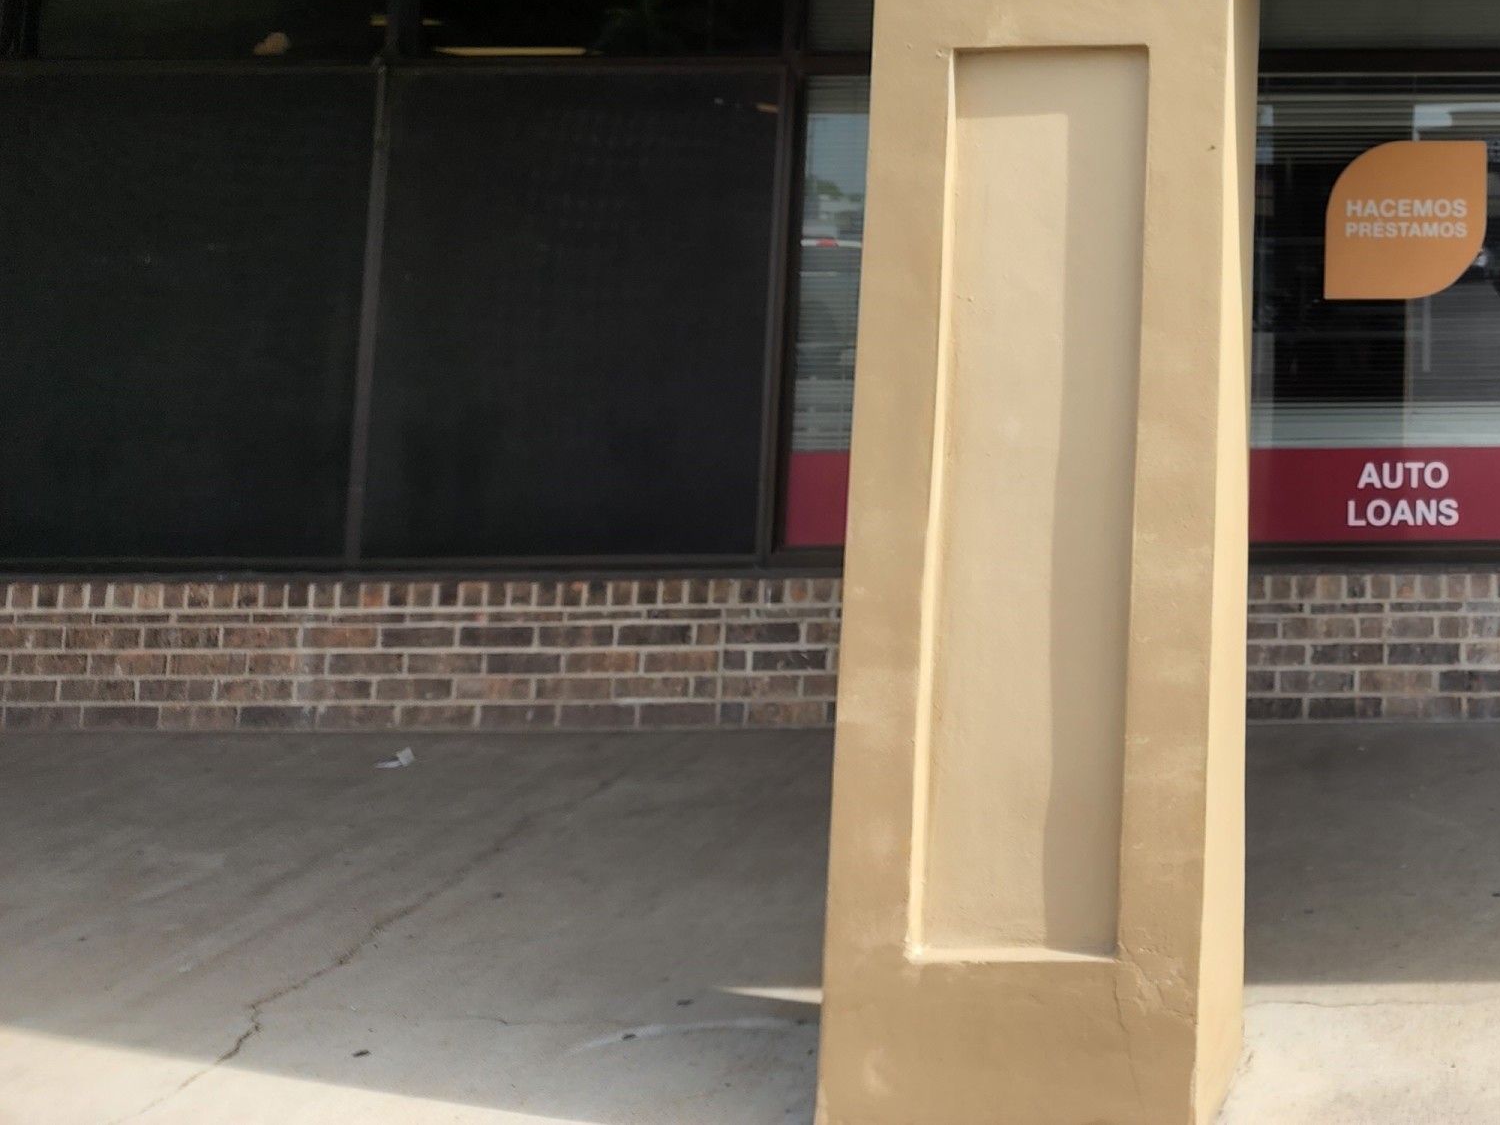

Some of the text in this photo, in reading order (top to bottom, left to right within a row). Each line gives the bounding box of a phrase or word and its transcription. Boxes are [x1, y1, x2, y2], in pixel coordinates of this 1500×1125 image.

[1346, 198, 1468, 218] HACEMOS
[1346, 219, 1468, 239] PRÉSTAMOS
[1358, 461, 1450, 489] AUTO
[1348, 498, 1460, 527] LOANS
